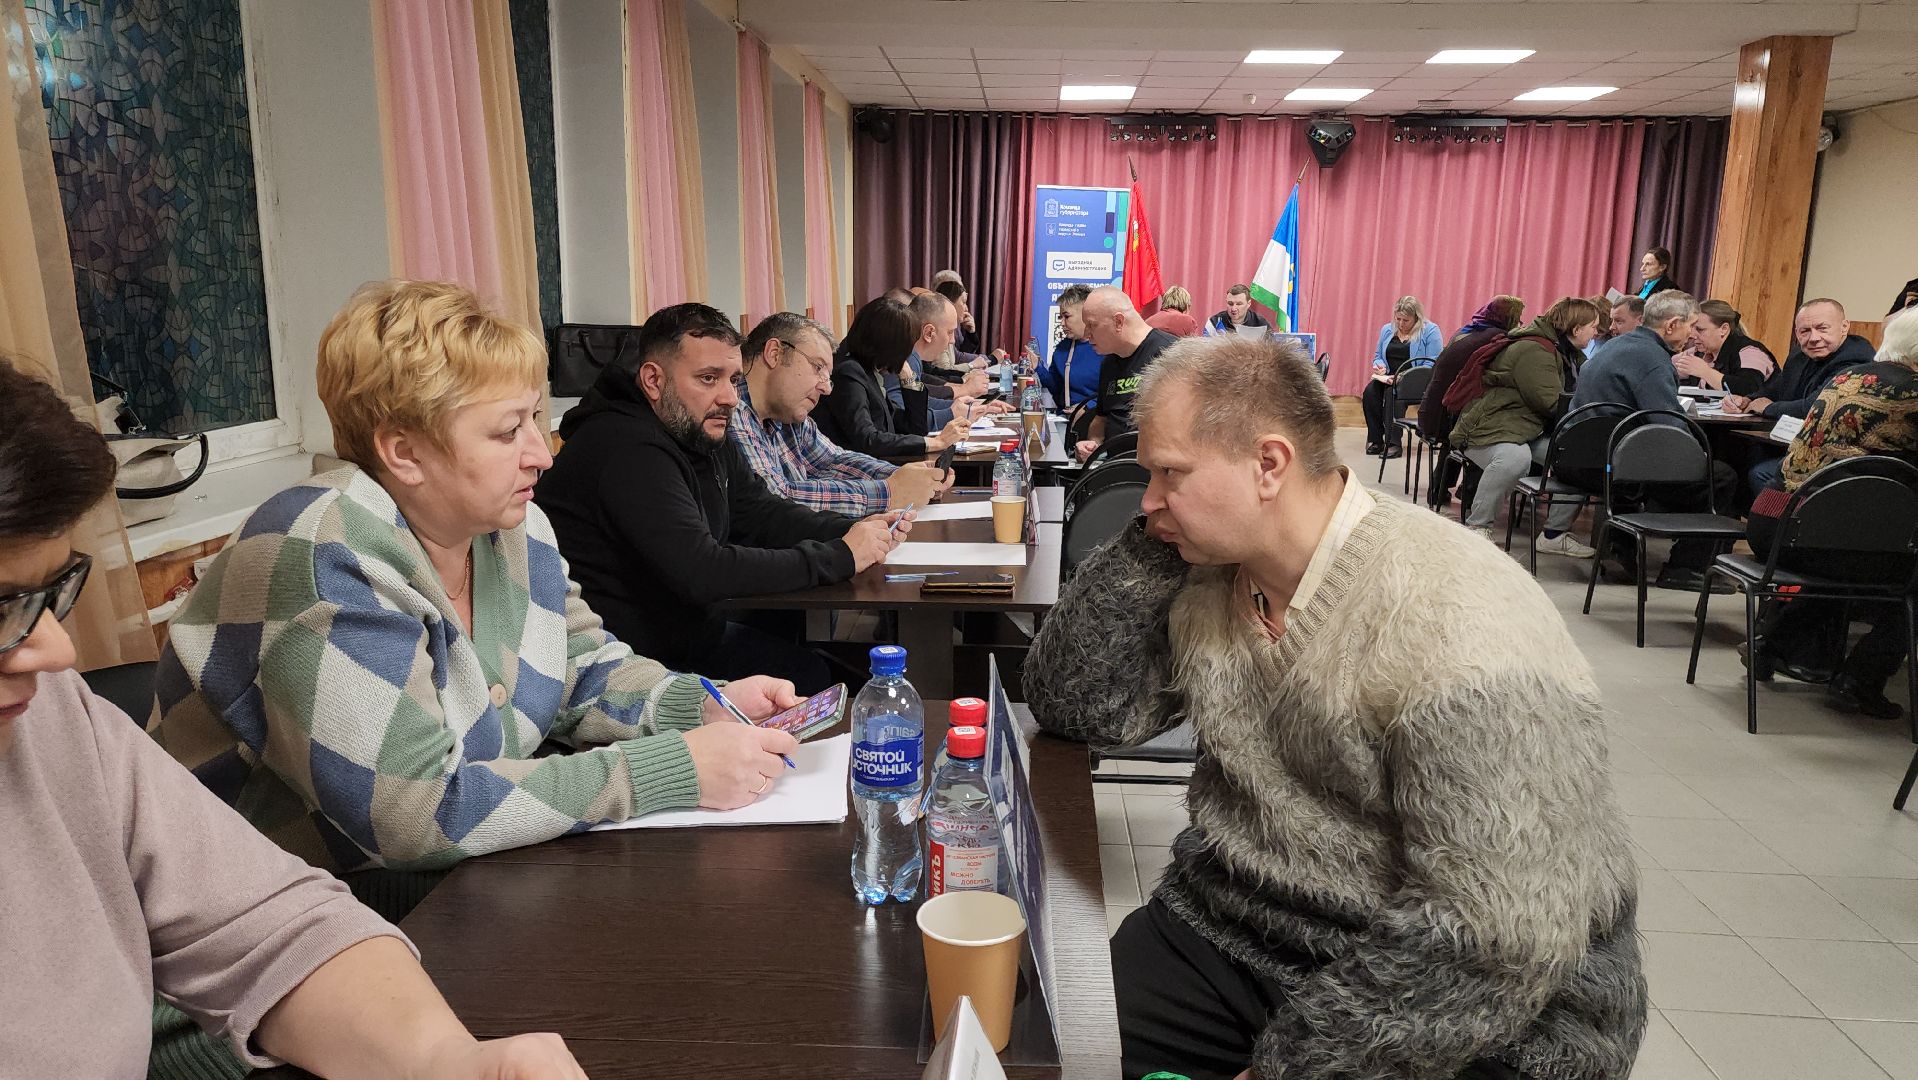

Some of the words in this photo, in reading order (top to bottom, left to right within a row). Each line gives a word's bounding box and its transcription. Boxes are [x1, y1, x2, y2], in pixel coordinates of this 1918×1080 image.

[855, 747, 905, 764] СВЯТОЙ
[951, 871, 974, 880] МОЖНО
[961, 878, 991, 886] ДОВЕРЯТЬ
